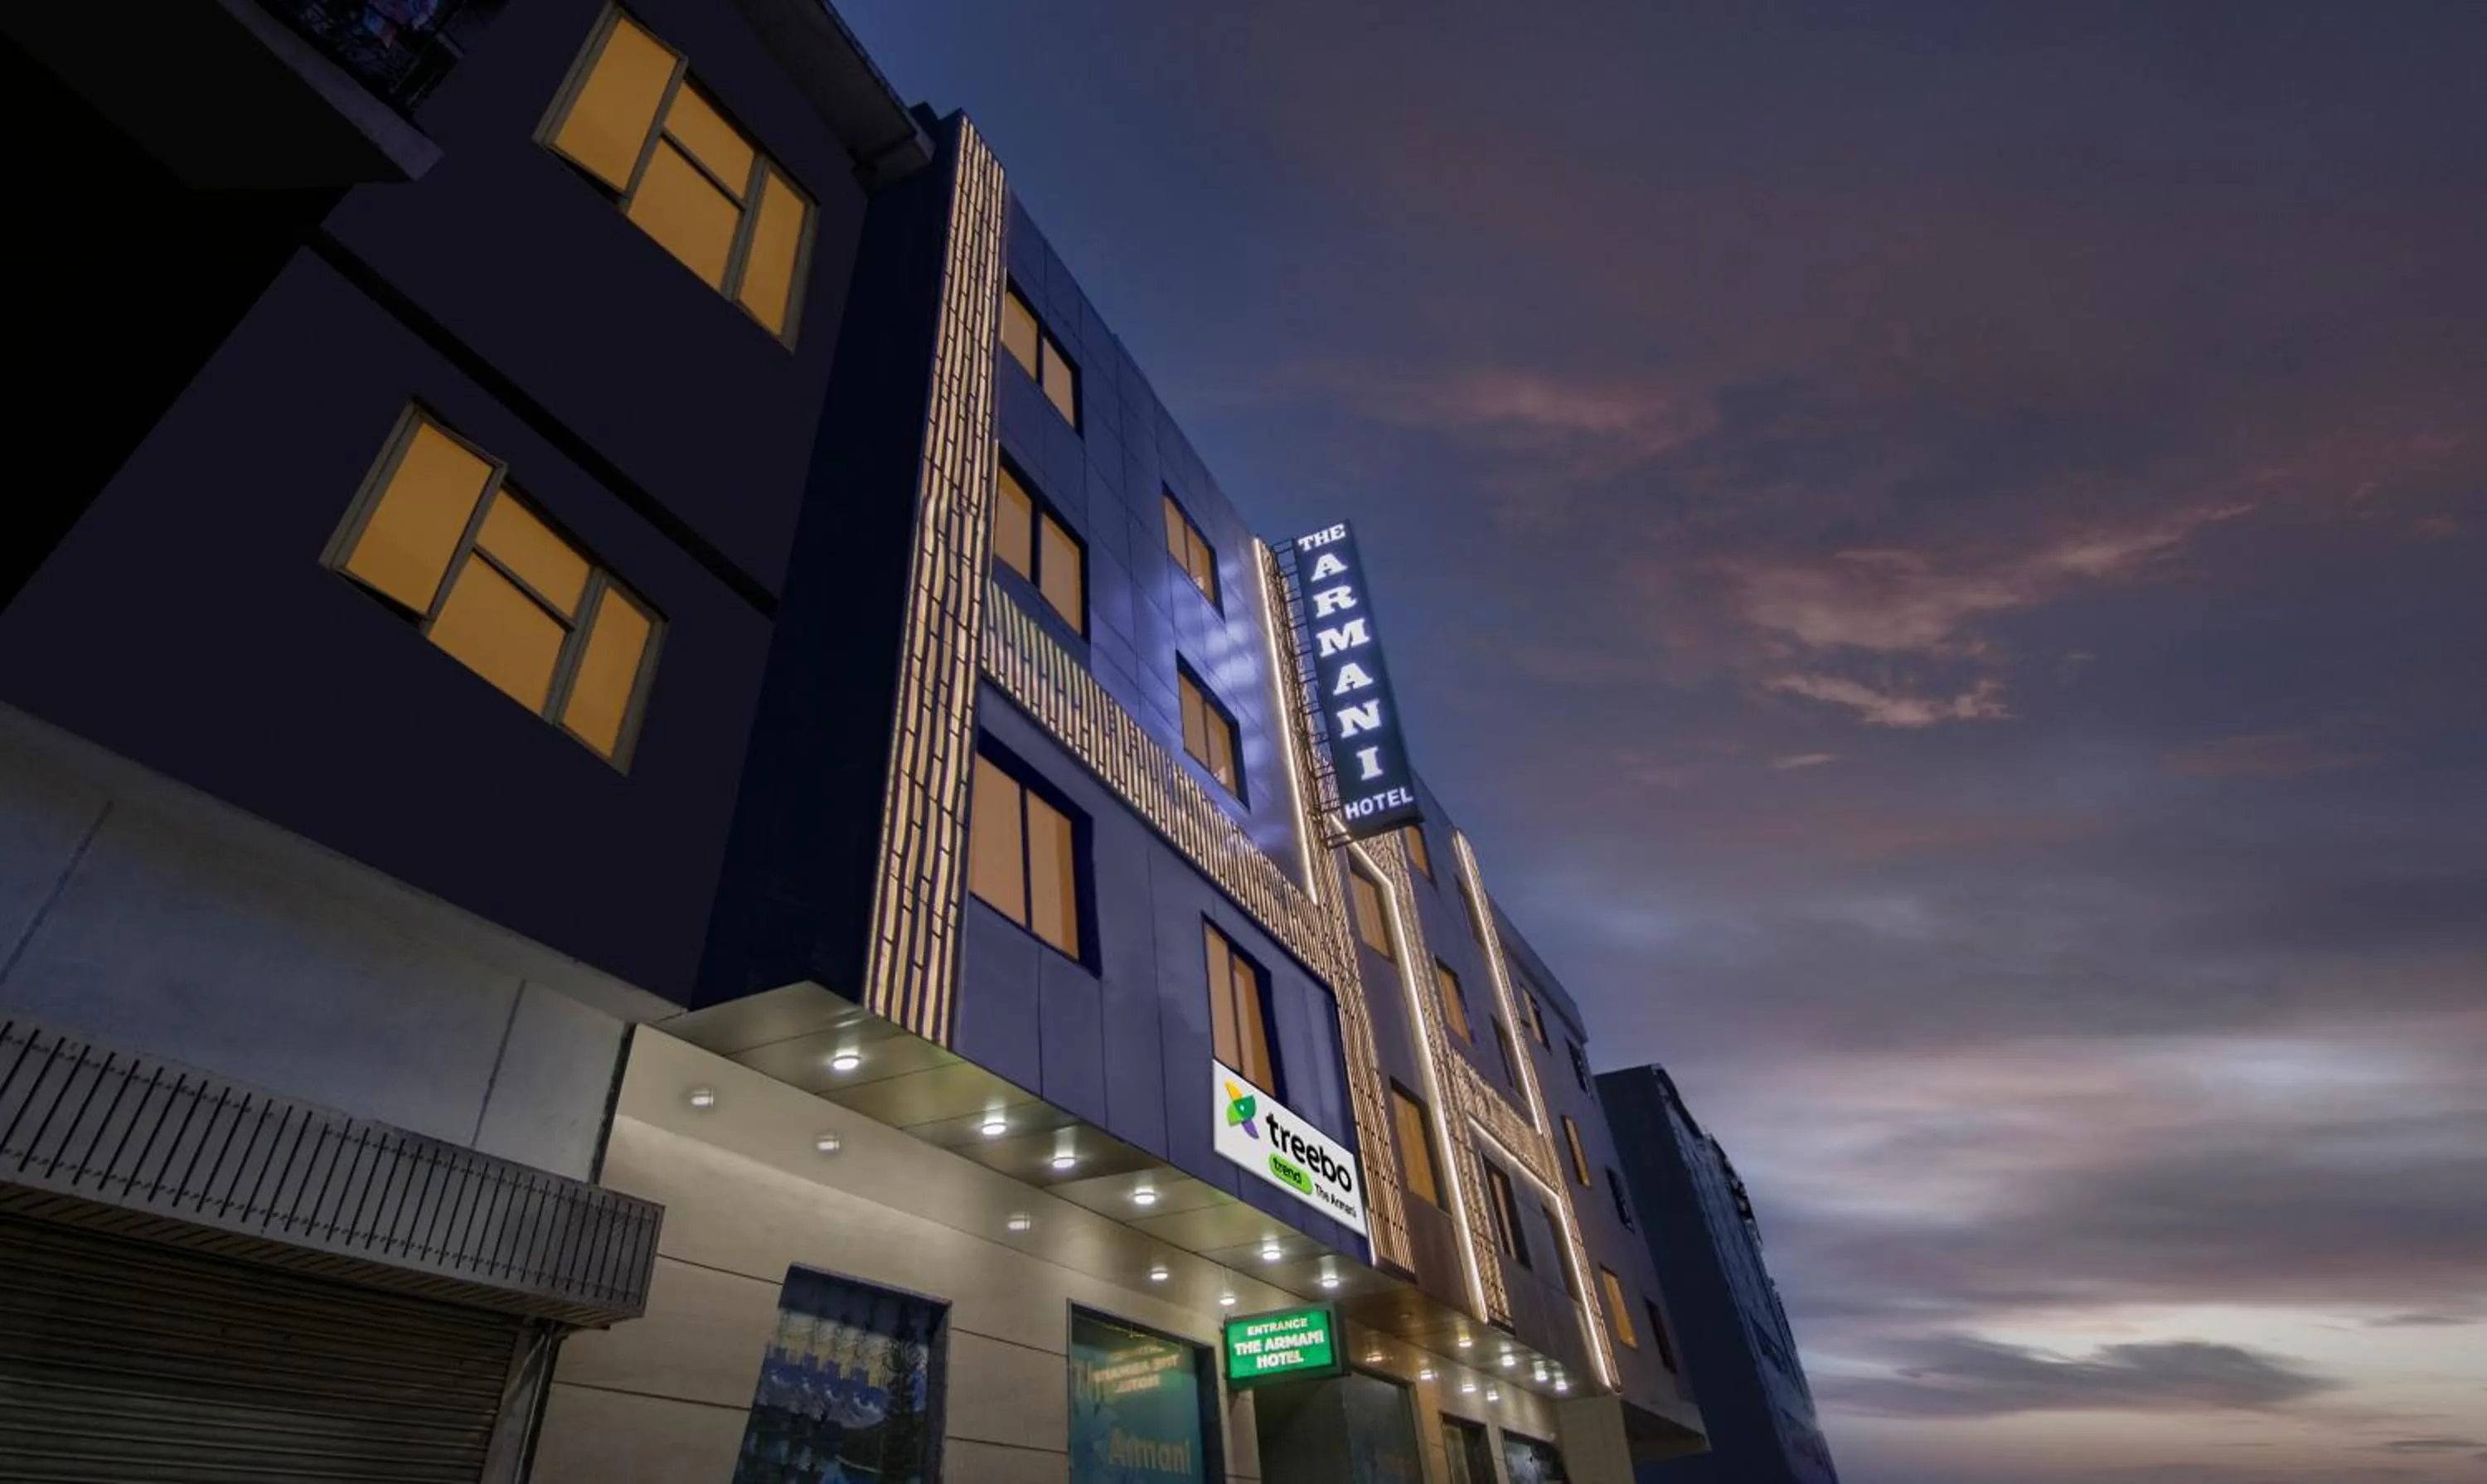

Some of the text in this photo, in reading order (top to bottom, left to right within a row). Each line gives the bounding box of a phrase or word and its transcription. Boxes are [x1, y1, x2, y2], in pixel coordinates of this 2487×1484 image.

[1298, 523, 1346, 551] THE
[1310, 553, 1384, 780] ARMANI
[1344, 787, 1414, 821] HOTEL
[1266, 1112, 1353, 1193] treebo
[1273, 1157, 1303, 1185] trend
[1247, 1317, 1308, 1336] ENTRANCE
[1234, 1329, 1325, 1355] THE ARMANI
[1256, 1350, 1304, 1369] HOTEL
